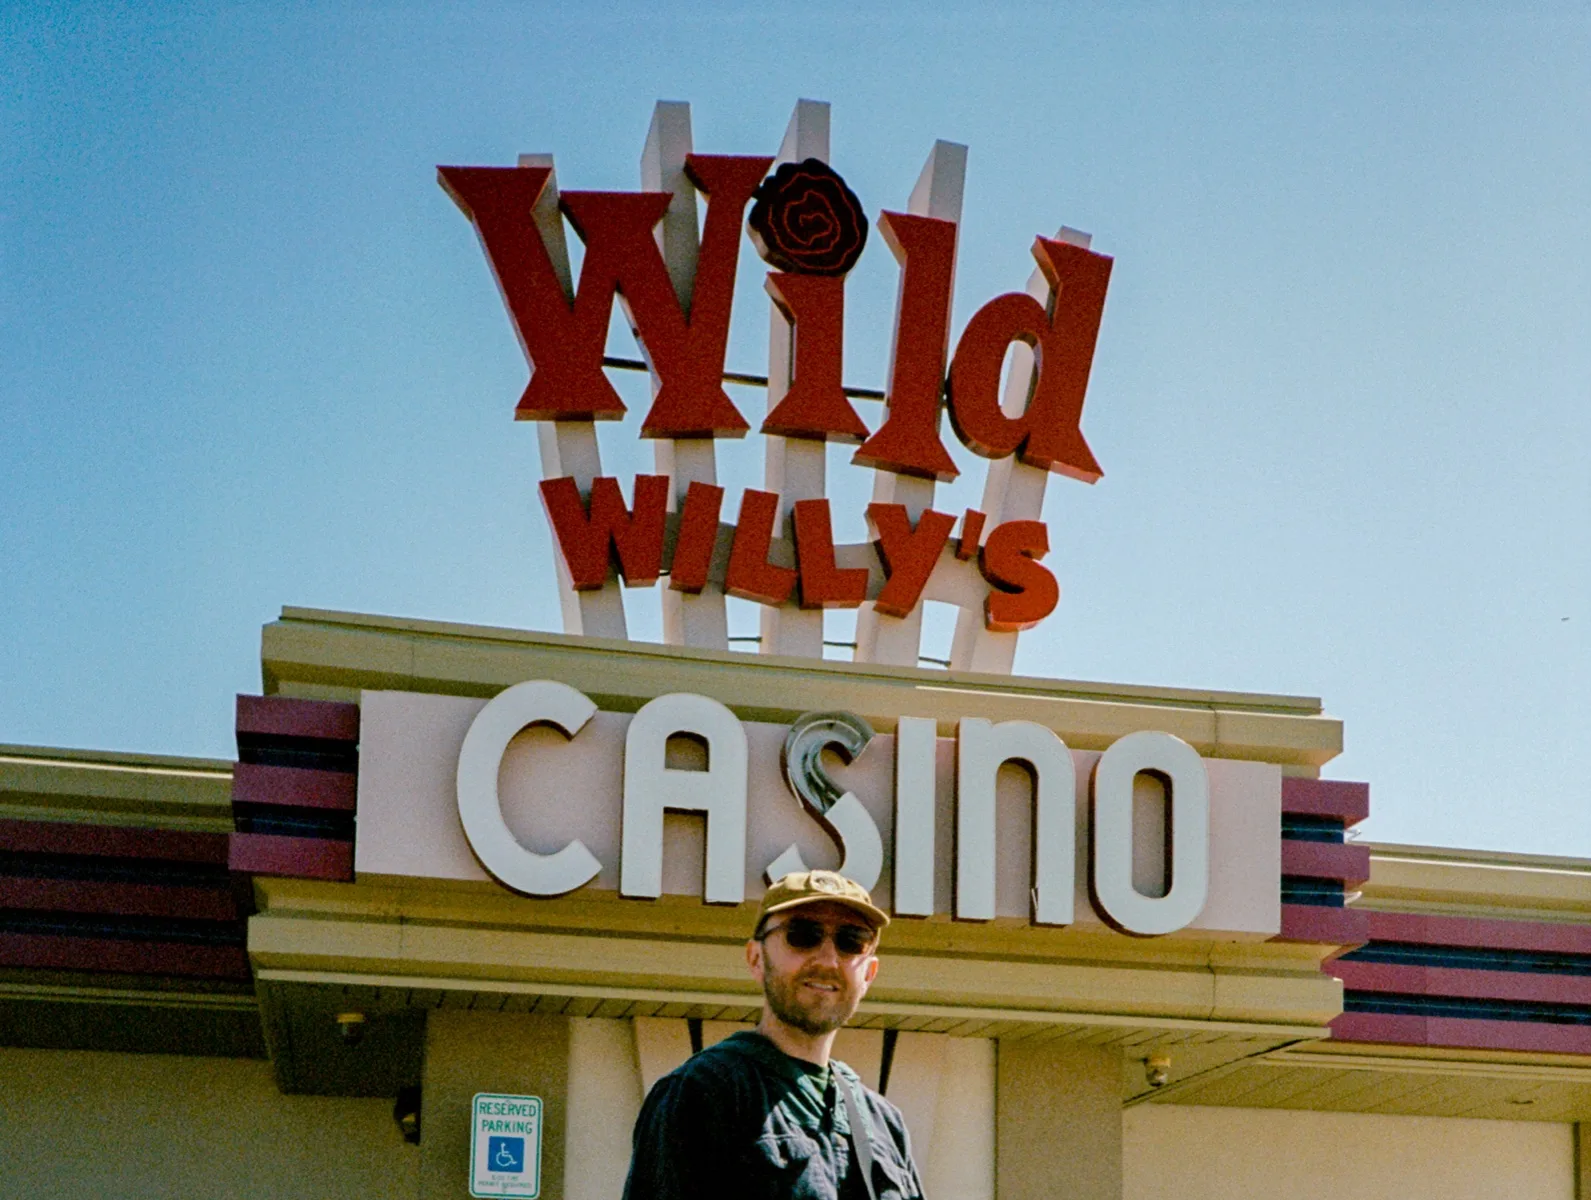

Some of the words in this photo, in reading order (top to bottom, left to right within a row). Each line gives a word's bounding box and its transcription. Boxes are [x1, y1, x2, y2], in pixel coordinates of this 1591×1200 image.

[436, 153, 1114, 484] Wild
[537, 474, 1060, 632] WILLY'S
[455, 679, 1210, 936] CASINO
[479, 1101, 537, 1117] RESERVED
[482, 1119, 533, 1135] PARKING
